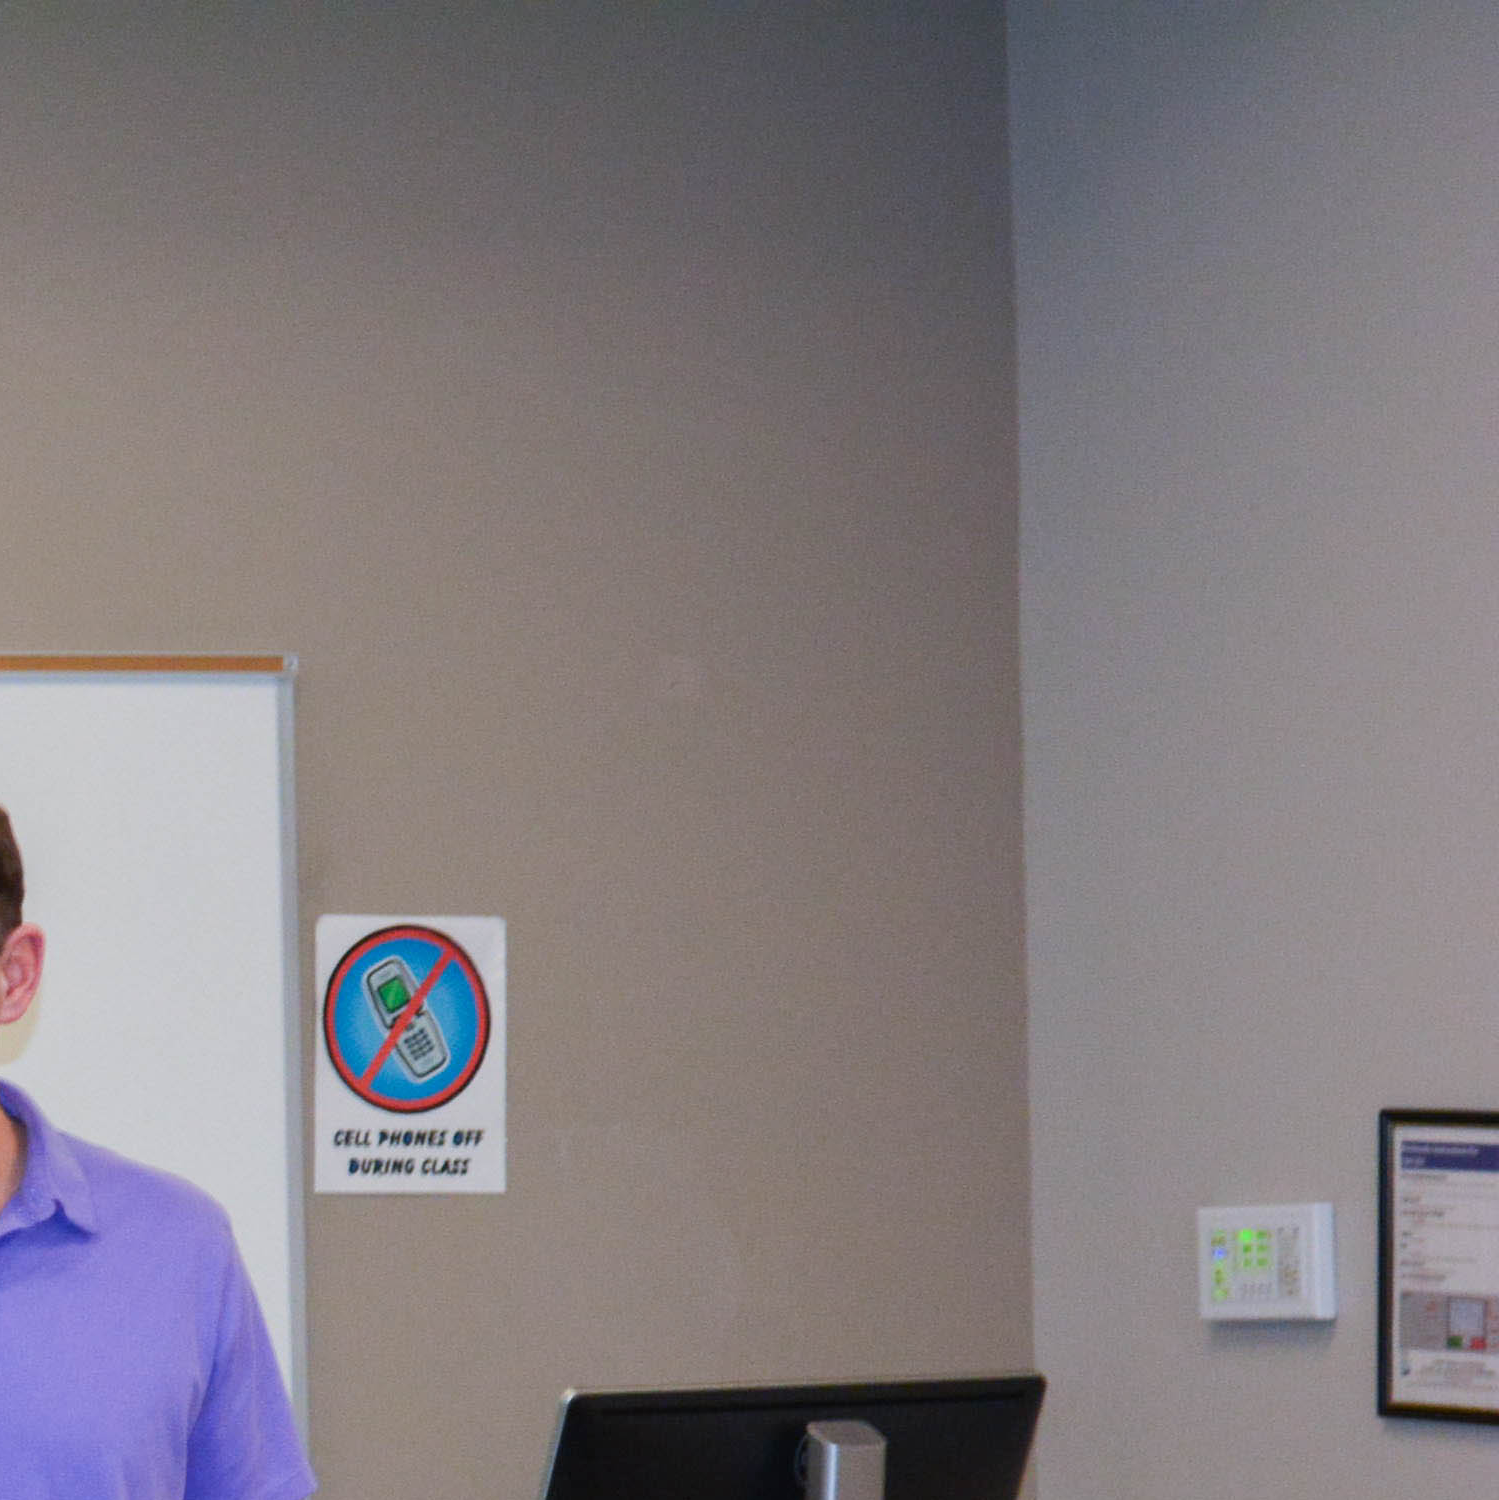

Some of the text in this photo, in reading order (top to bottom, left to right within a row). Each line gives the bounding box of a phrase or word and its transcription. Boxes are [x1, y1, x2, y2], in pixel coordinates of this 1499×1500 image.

[334, 1130, 485, 1146] CELL PHONES OFF
[348, 1158, 471, 1175] DURING CLASS
